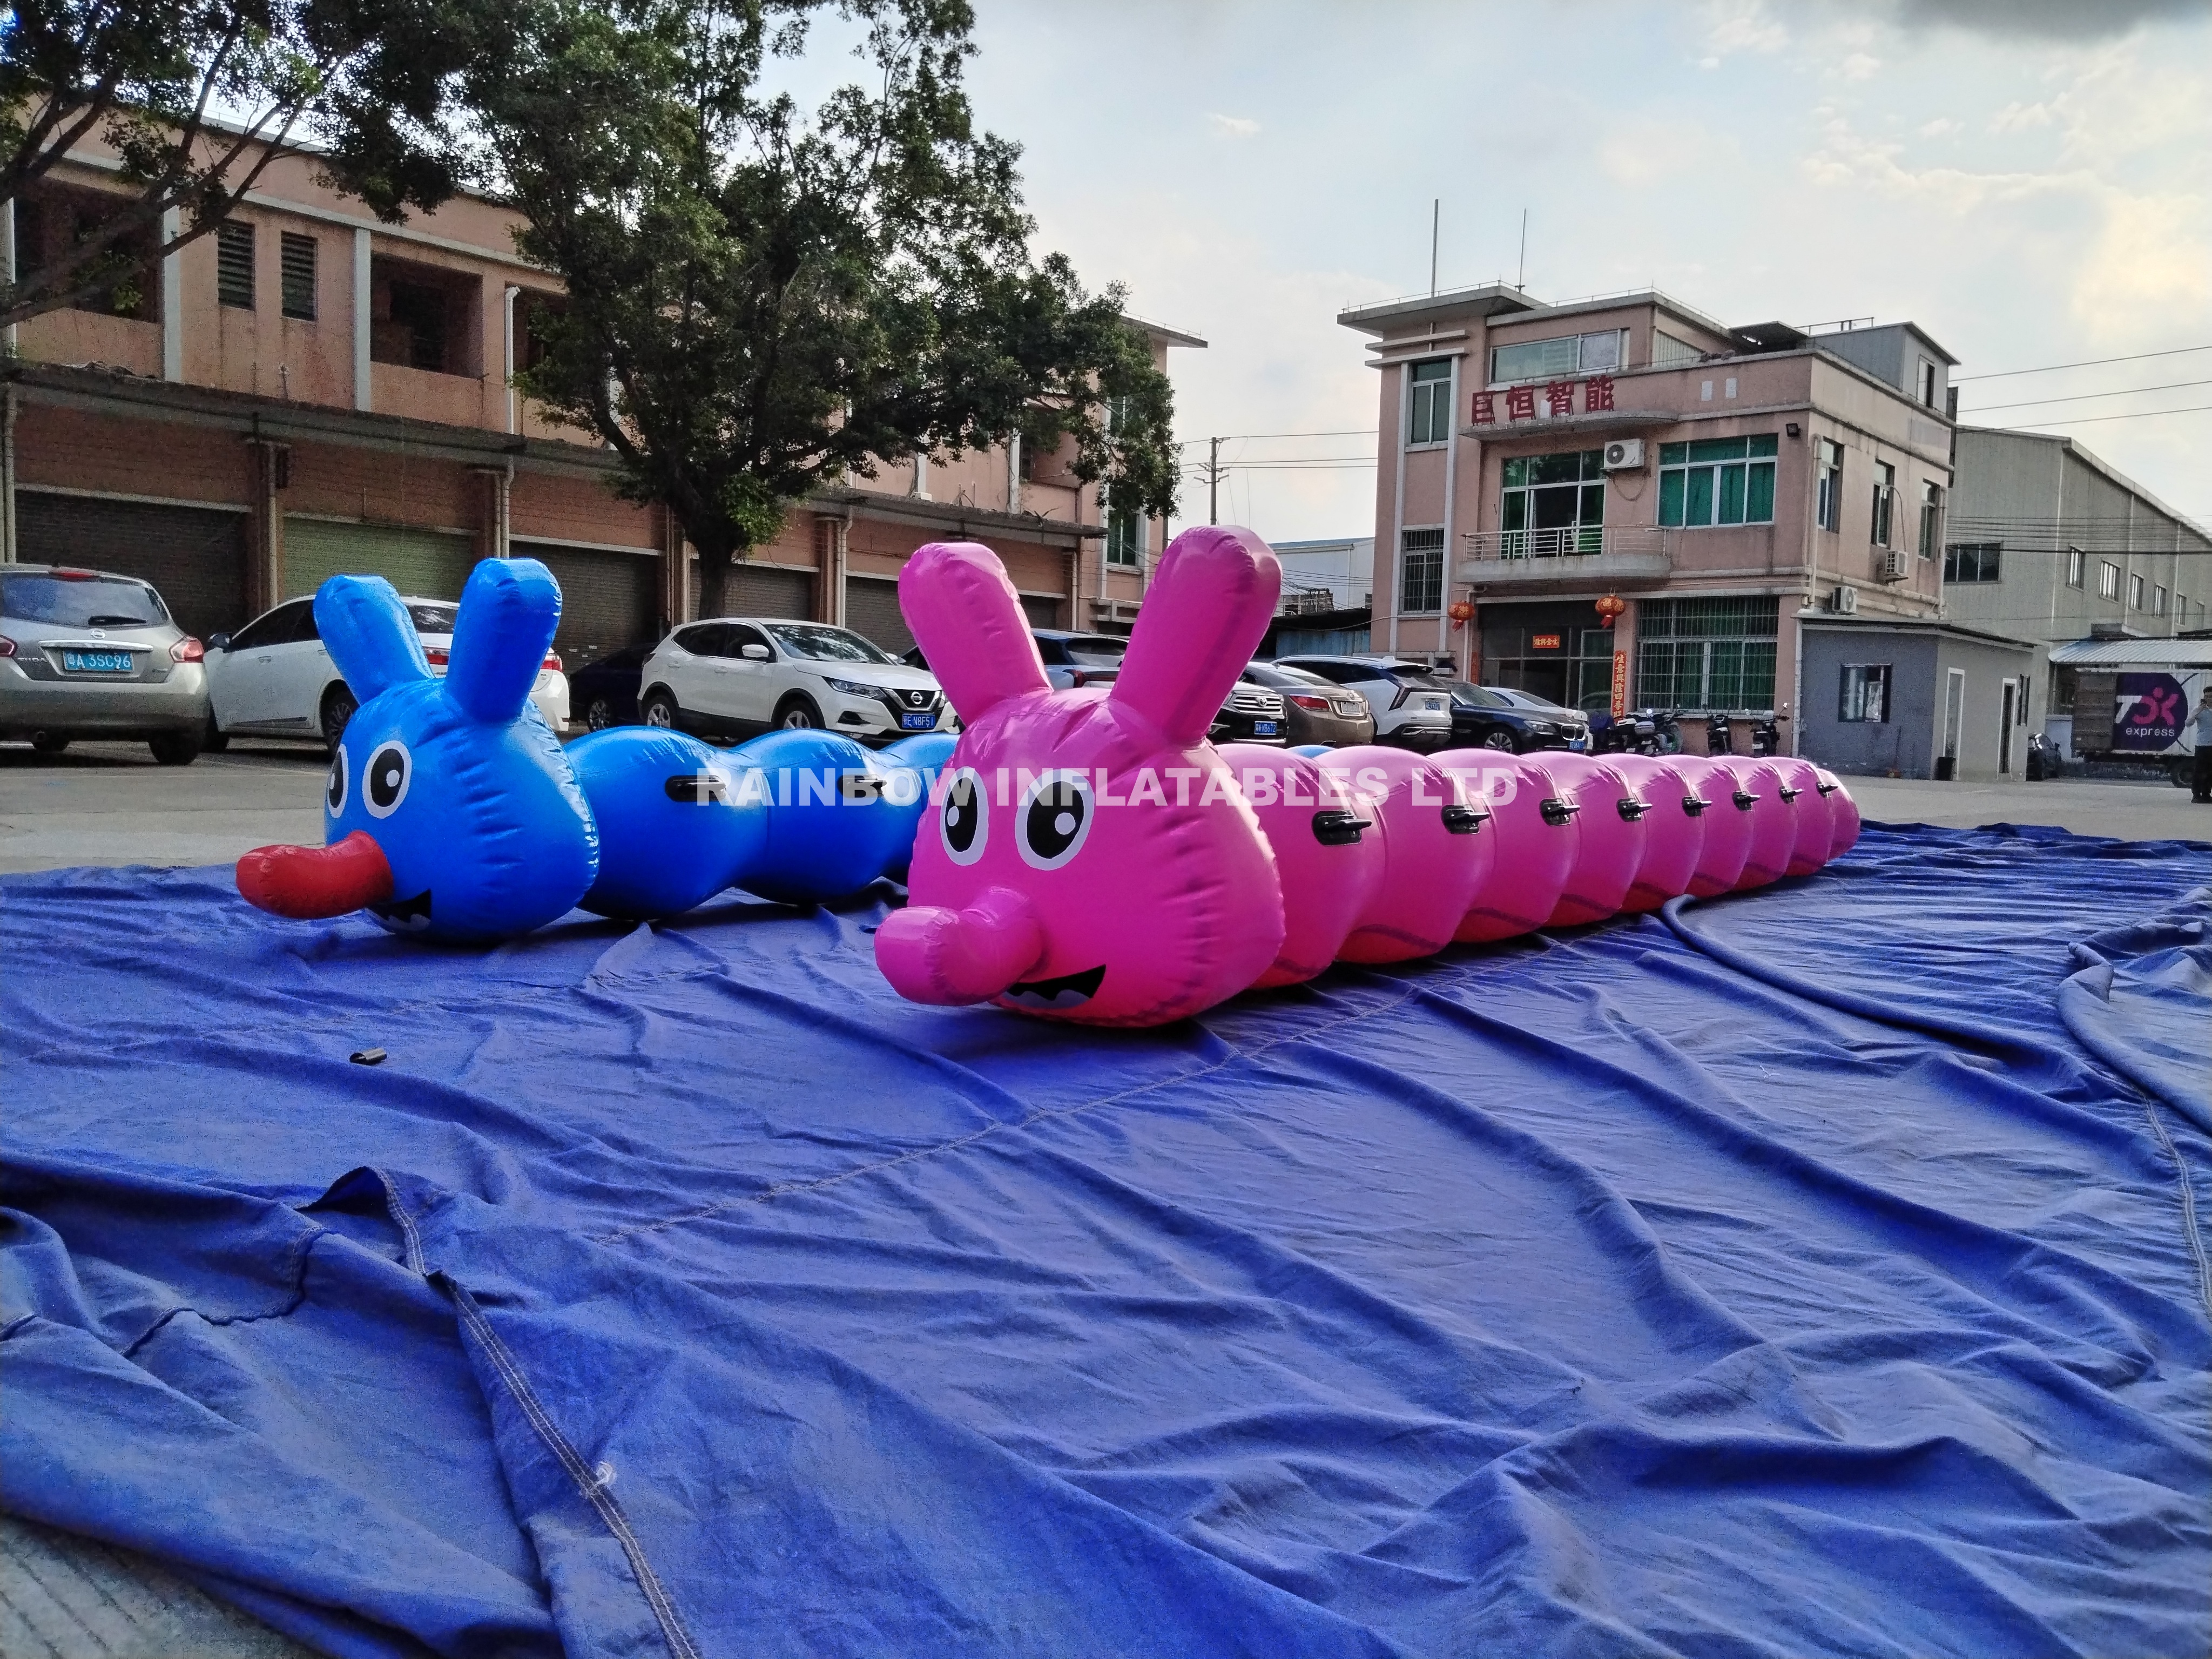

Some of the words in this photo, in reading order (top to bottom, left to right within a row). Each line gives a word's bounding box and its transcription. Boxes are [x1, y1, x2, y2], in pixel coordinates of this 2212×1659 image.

[1472, 375, 1614, 424] 巨恒智能
[2126, 727, 2175, 737] express
